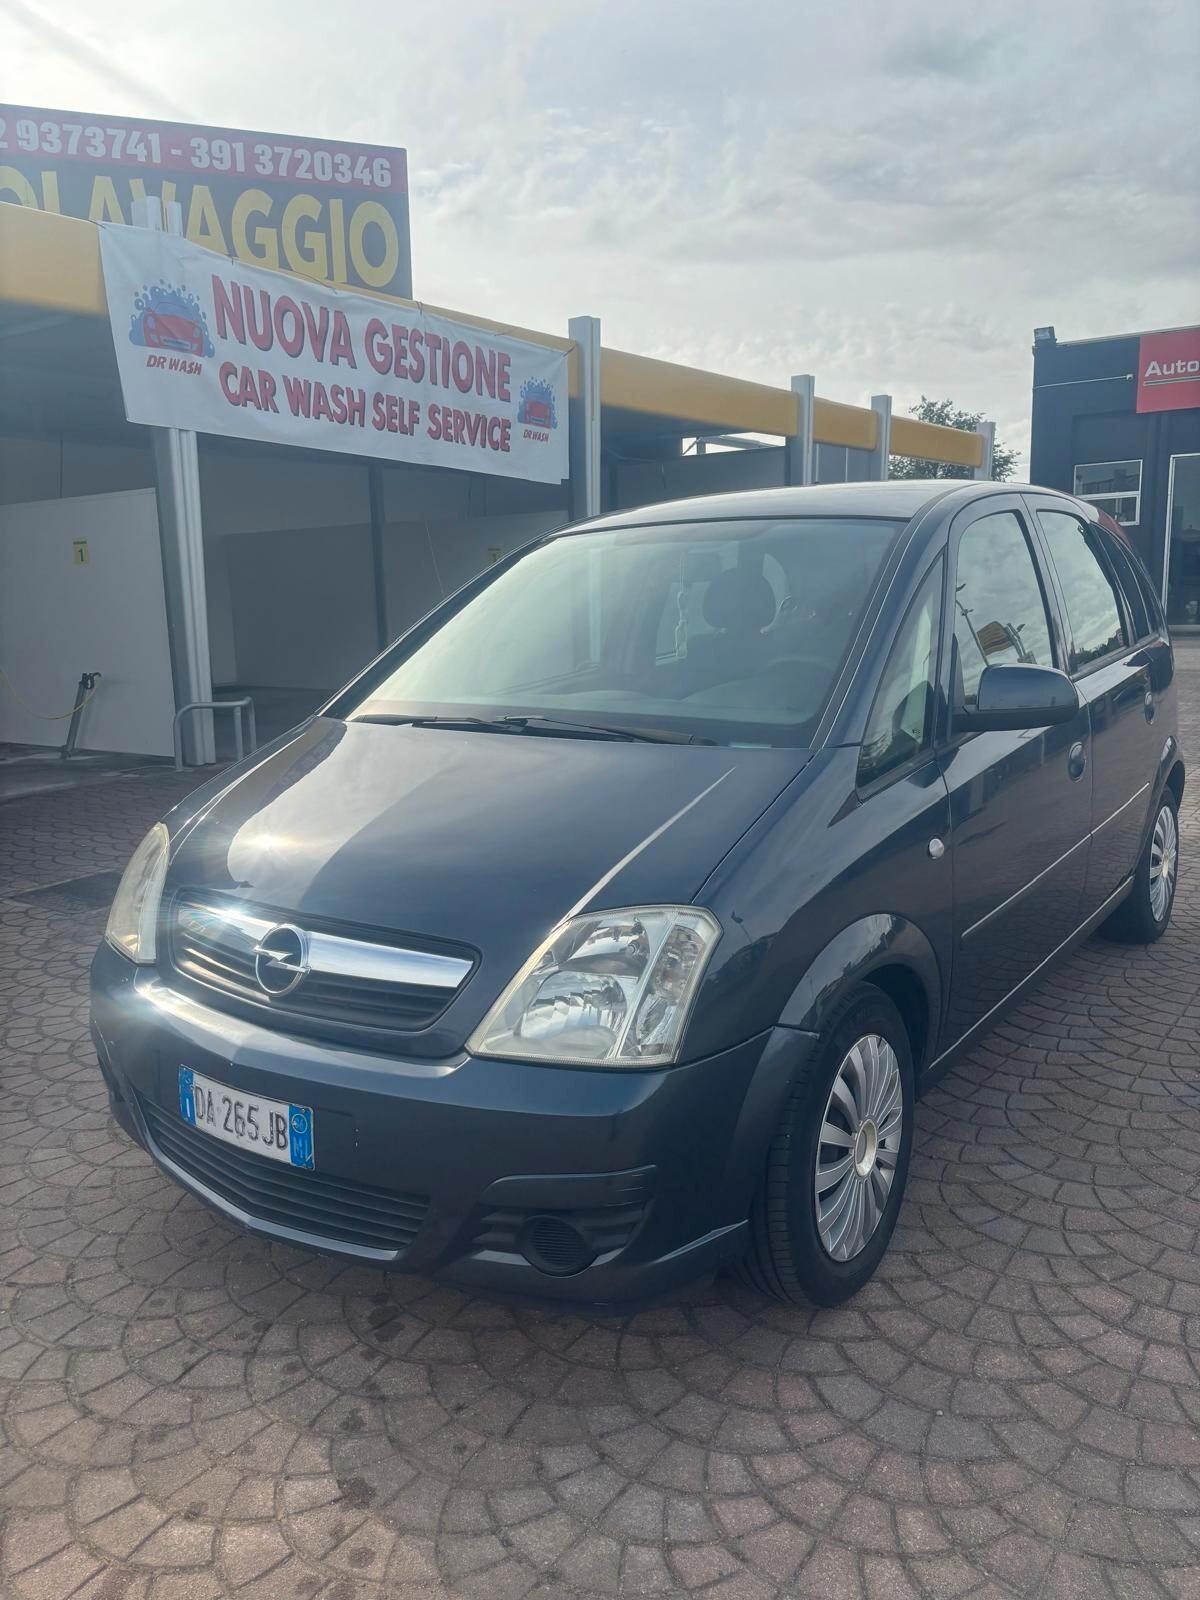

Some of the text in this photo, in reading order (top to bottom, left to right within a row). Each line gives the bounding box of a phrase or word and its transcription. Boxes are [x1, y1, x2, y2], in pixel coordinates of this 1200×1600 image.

[16, 119, 161, 164] 9373741
[190, 137, 245, 172] 391
[254, 144, 392, 188] 3720346
[147, 355, 202, 375] DR WASH
[212, 274, 511, 402] NUOVA GESTIONE
[1144, 360, 1200, 377] Auto
[219, 361, 511, 452] CAR WASH SELF SERVICE
